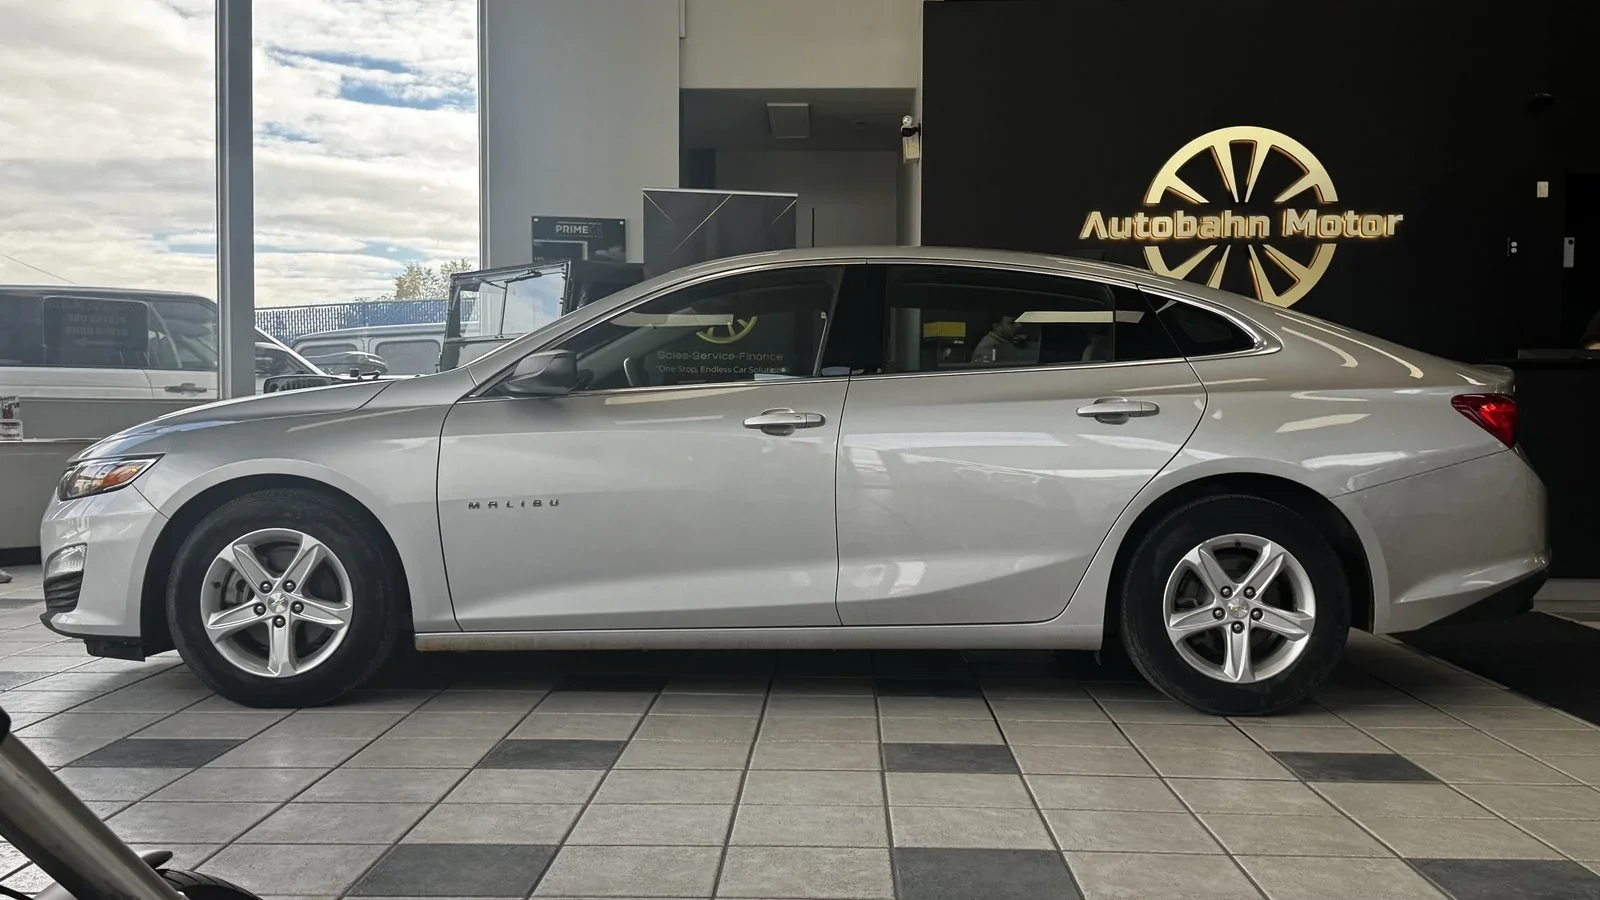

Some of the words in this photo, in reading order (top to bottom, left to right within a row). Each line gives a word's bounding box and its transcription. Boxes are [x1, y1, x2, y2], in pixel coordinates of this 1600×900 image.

[1080, 210, 1270, 239] Autobahn
[1283, 209, 1403, 238] Motor
[700, 365, 731, 373] Endless
[468, 499, 559, 509] MALIBU
